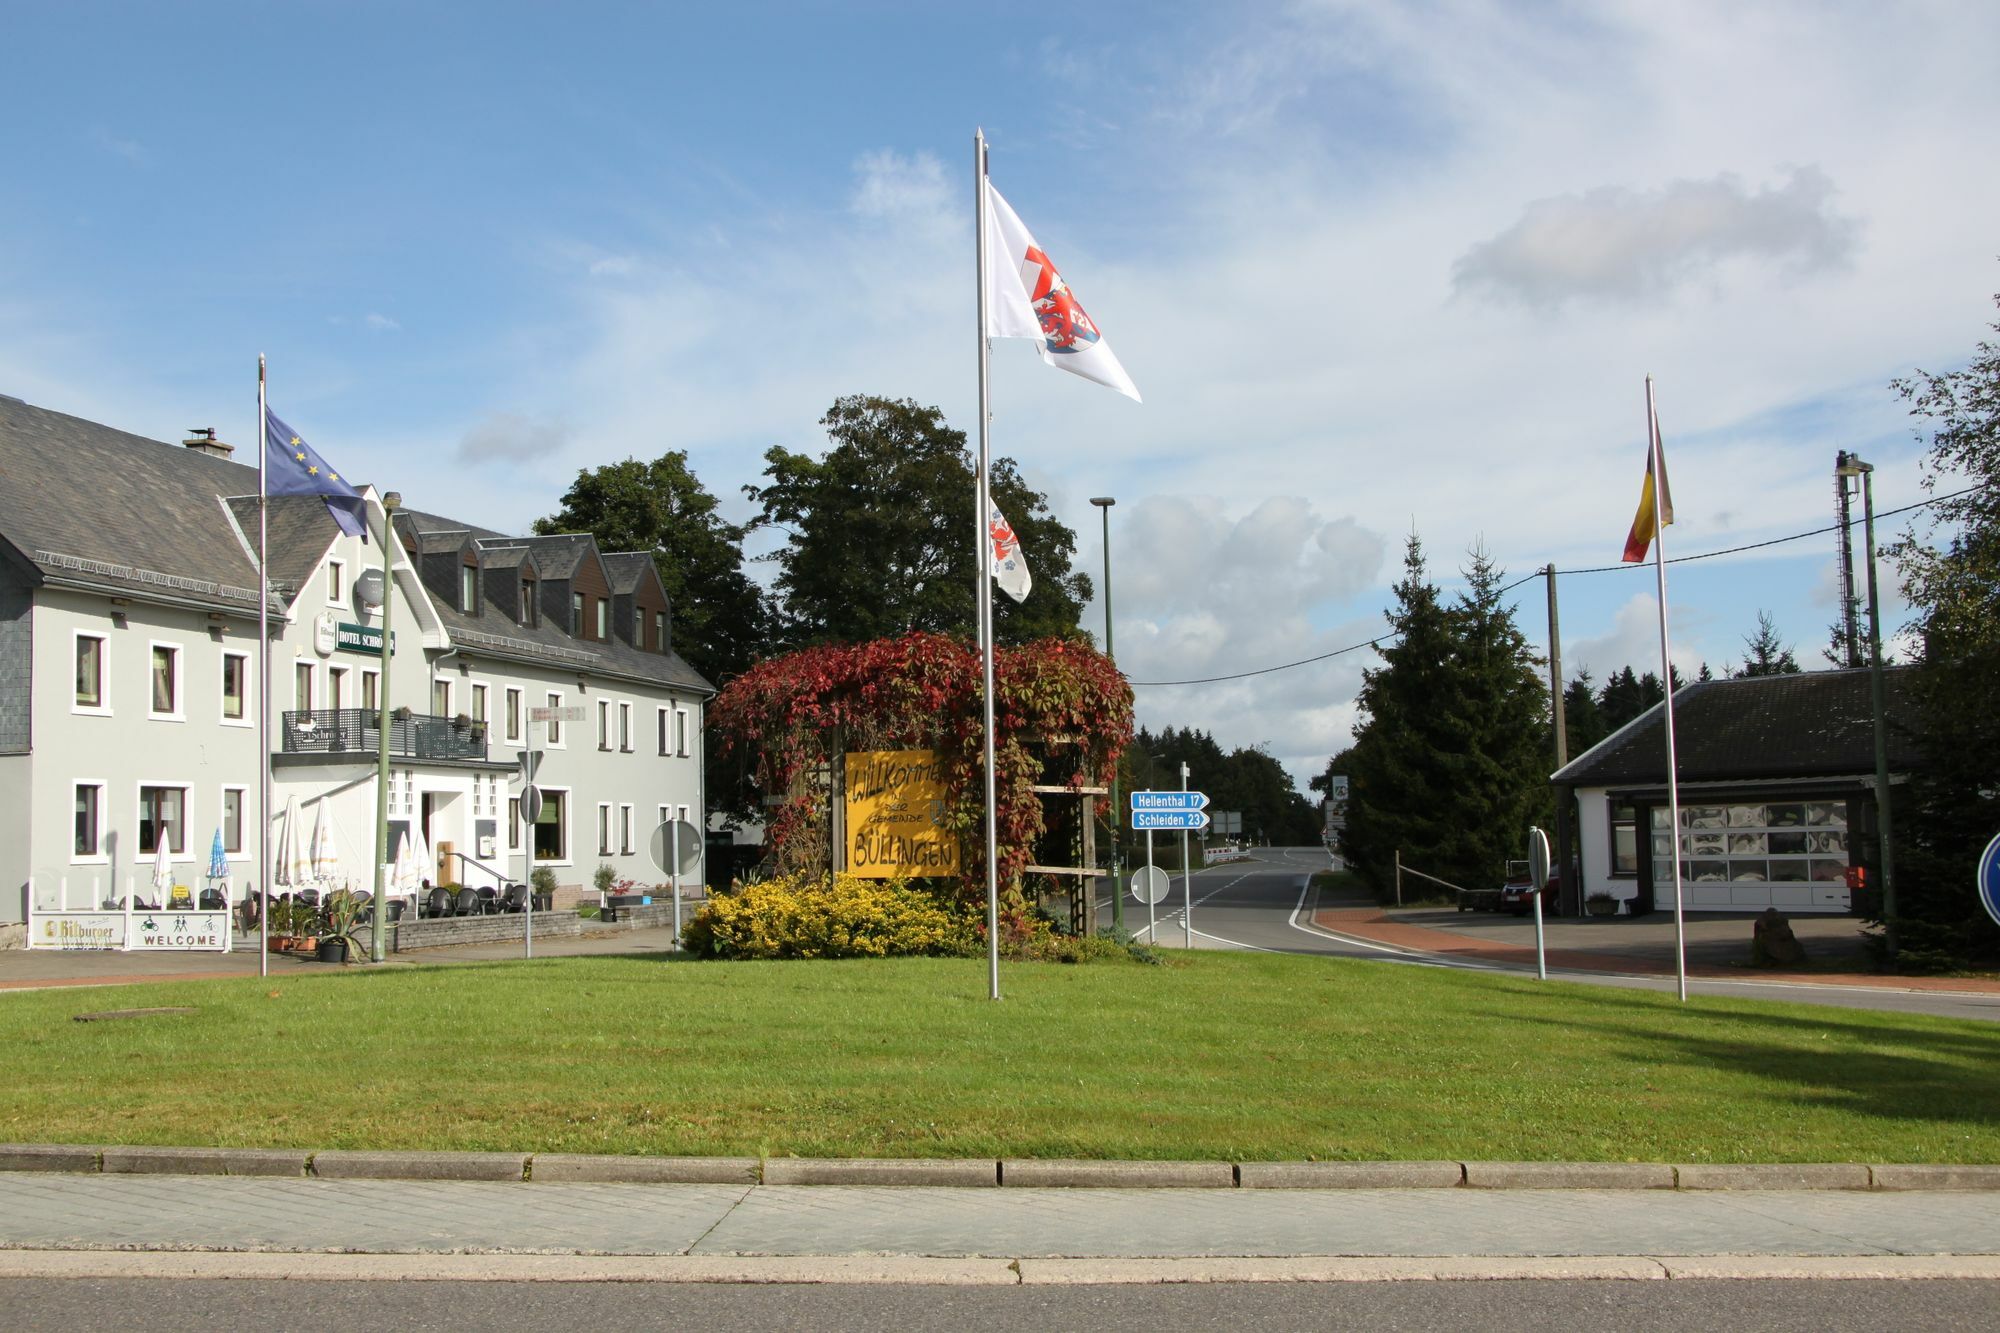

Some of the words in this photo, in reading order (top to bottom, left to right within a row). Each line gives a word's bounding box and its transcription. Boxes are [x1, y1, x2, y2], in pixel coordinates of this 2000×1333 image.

[339, 630, 361, 646] HOTEL
[362, 634, 395, 650] SCHRÖR
[1138, 795, 1186, 807] Hellenthal
[1190, 795, 1200, 807] 17
[868, 814, 924, 823] GEMEINDE
[1138, 813, 1184, 826] Schleiden
[1187, 813, 1200, 826] 23
[854, 827, 952, 867] BÜLLINGEN
[60, 920, 114, 938] Bitburger
[144, 935, 216, 946] WELCOME
